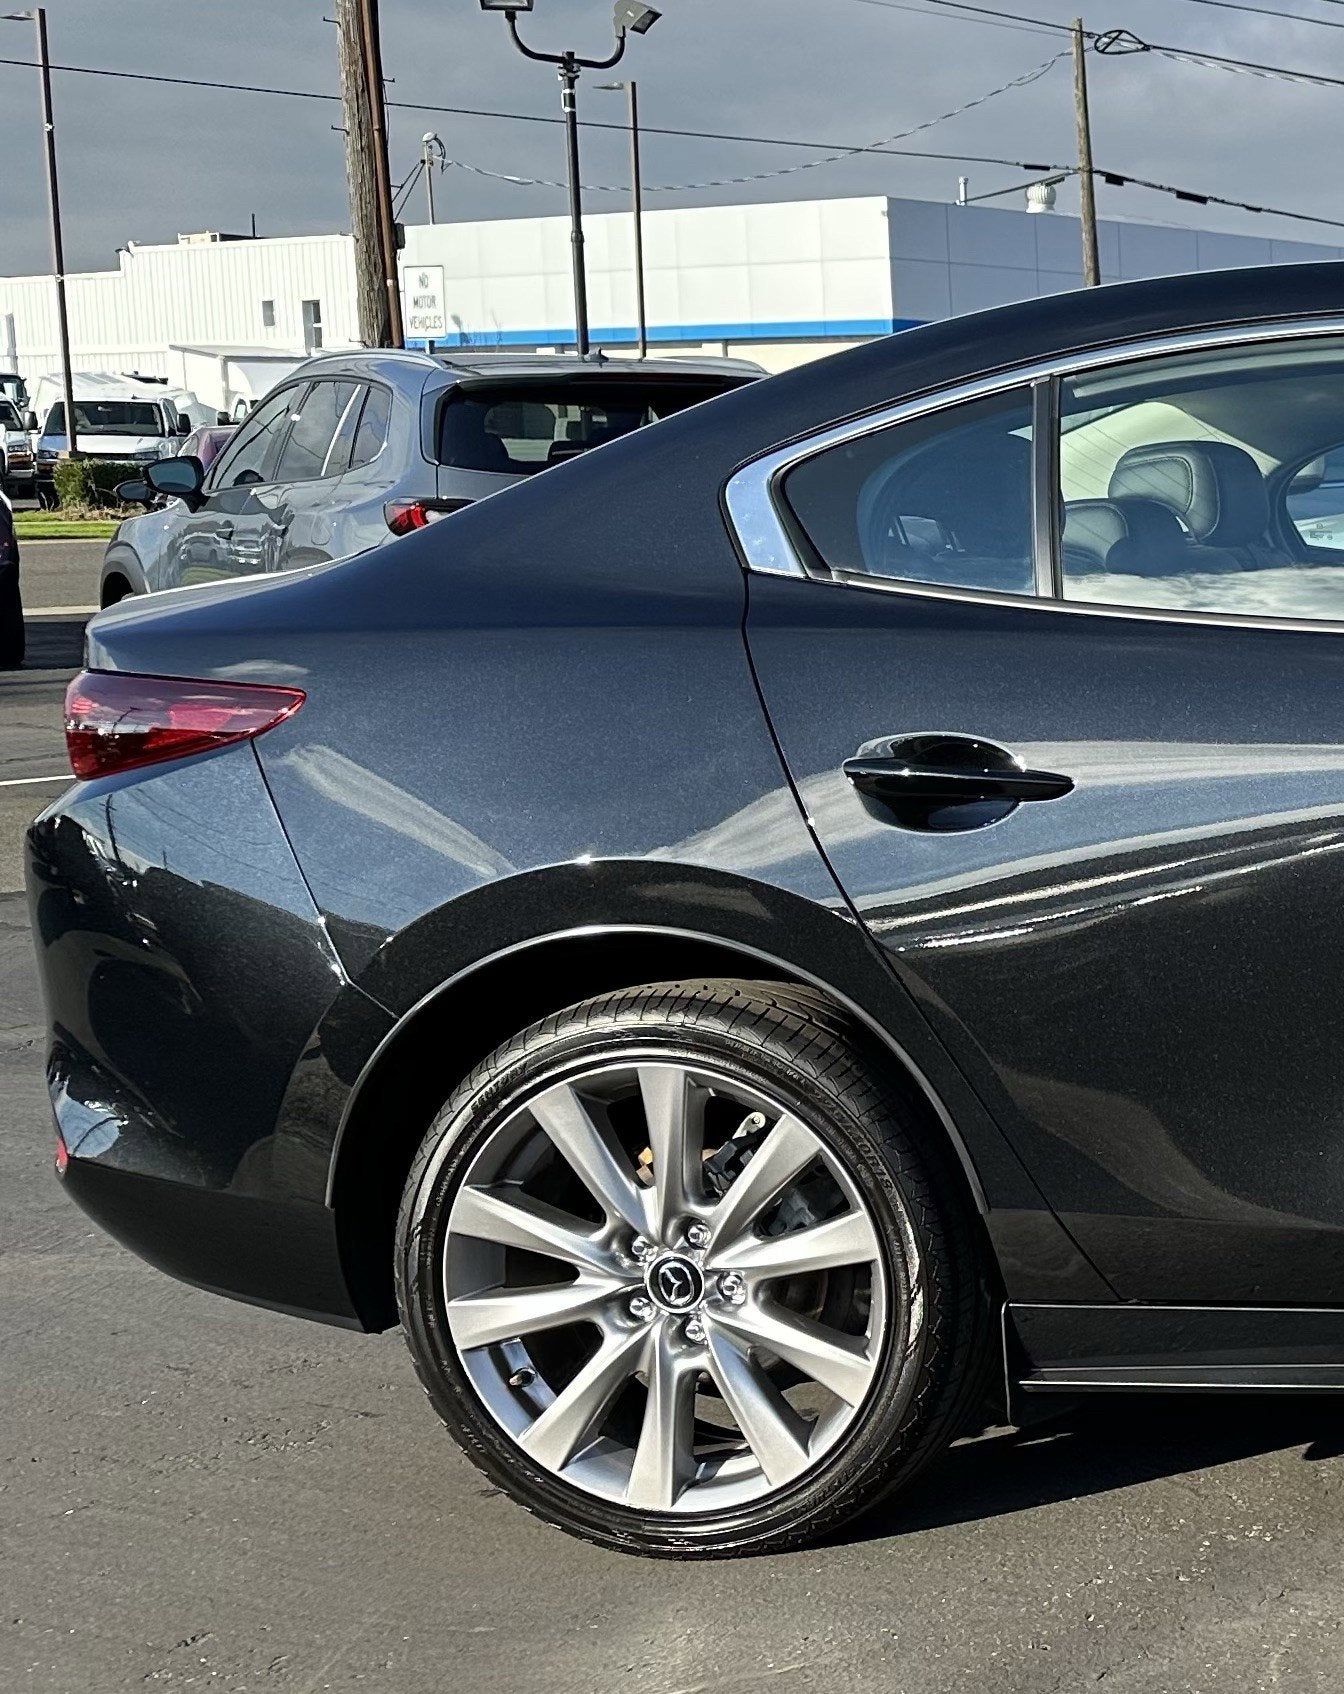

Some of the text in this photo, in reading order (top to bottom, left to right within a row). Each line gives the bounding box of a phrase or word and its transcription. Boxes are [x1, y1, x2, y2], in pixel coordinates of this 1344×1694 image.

[418, 273, 429, 289] NO
[412, 294, 437, 309] MOTOR
[409, 315, 443, 331] VEHICLES
